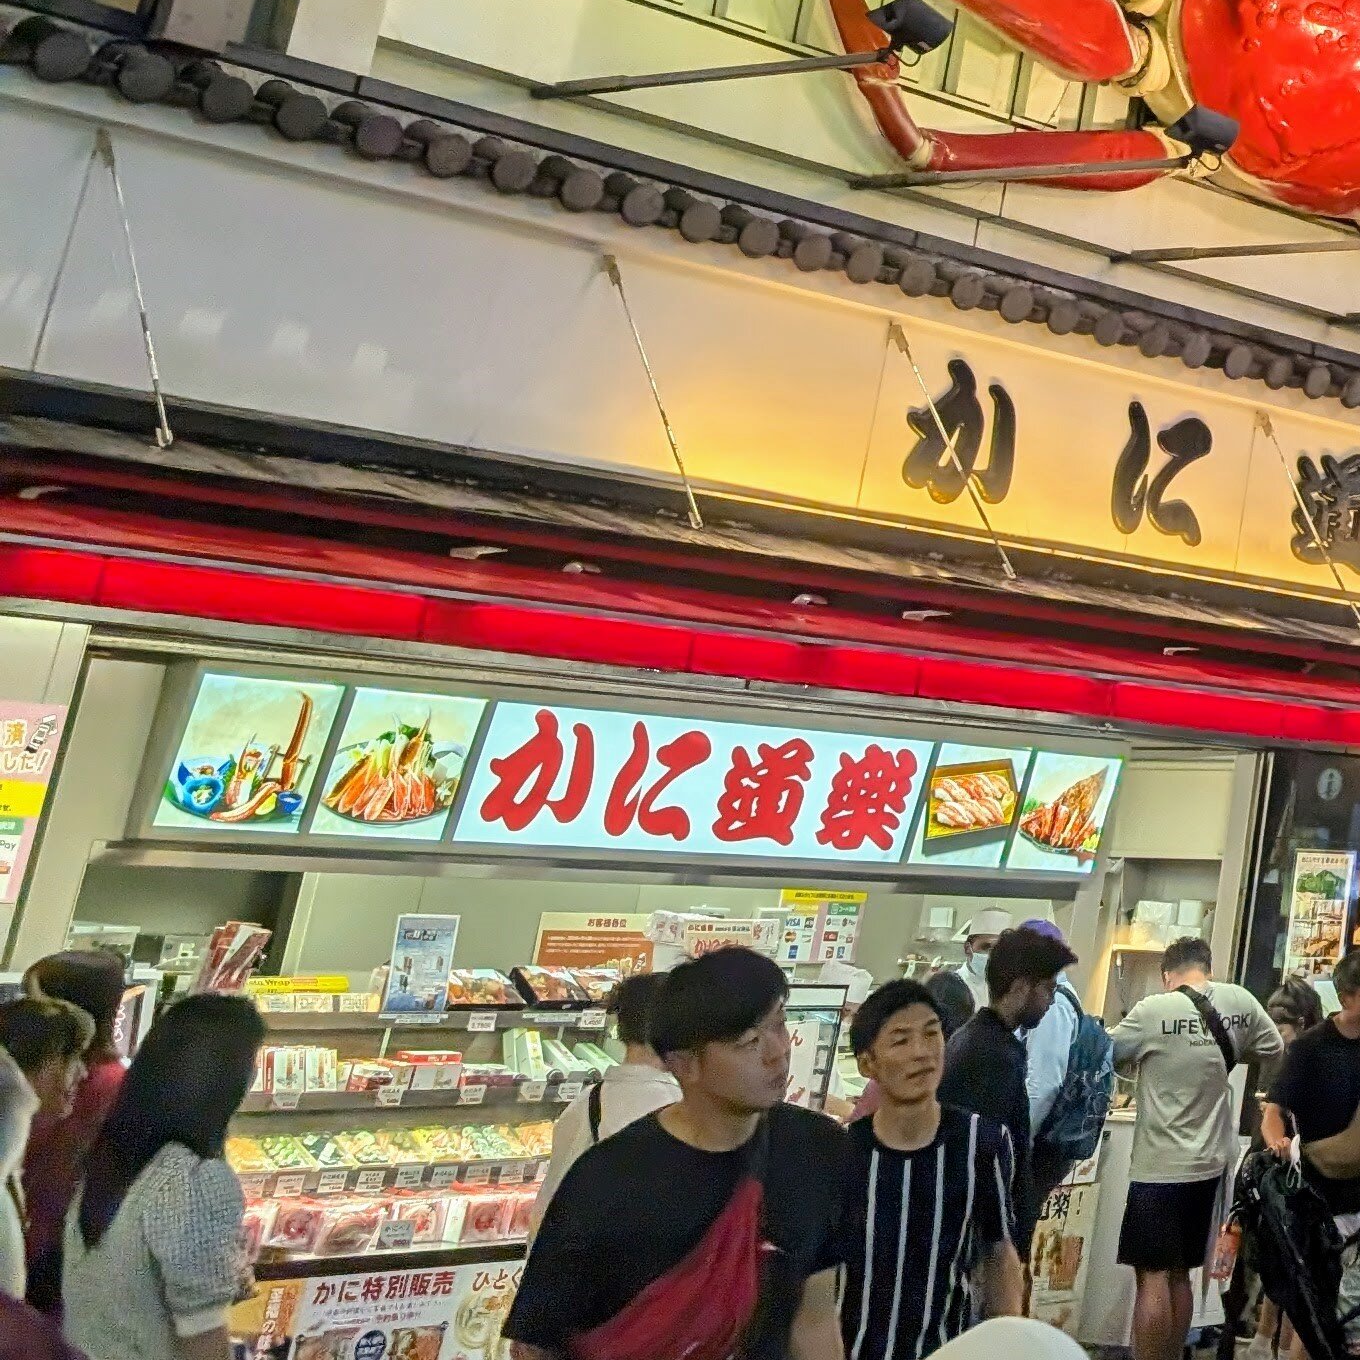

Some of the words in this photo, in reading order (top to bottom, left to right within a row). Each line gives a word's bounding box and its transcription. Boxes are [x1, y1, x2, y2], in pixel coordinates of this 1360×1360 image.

[312, 1270, 456, 1305] かに特別販売
